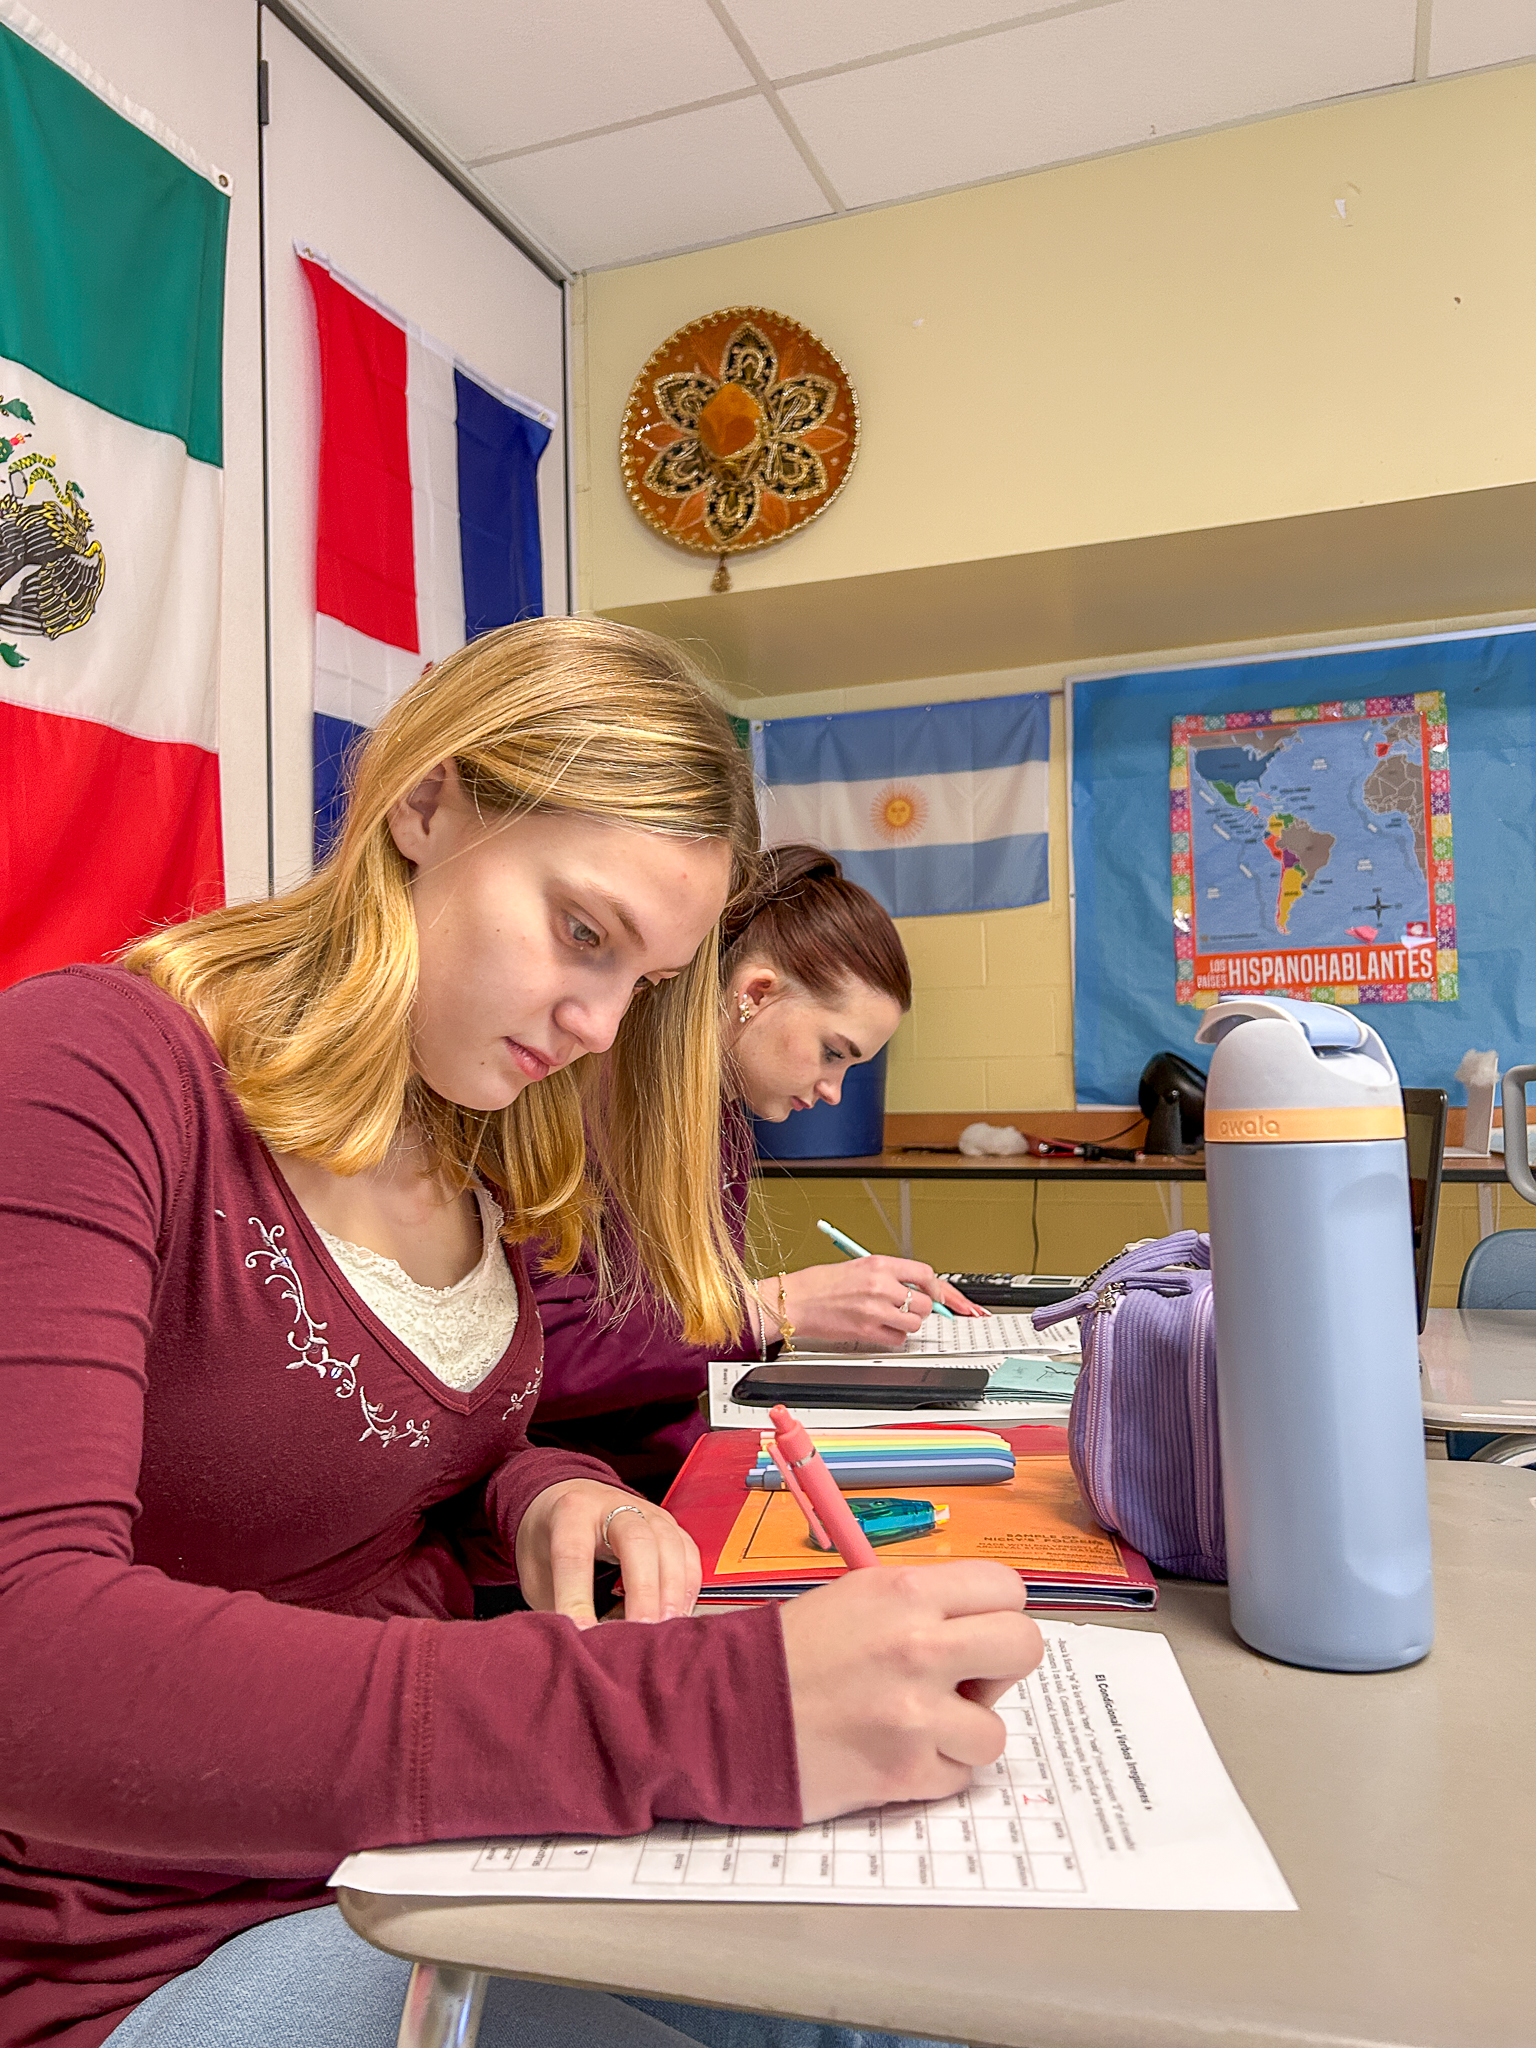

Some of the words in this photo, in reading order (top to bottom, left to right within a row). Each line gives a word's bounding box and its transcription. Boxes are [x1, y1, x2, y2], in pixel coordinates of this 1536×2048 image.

[1209, 958, 1228, 973] LOS
[1228, 947, 1433, 988] HISPANOHABLANTES
[1196, 972, 1228, 989] PAÍSES
[1219, 1114, 1280, 1138] owala
[1097, 1683, 1122, 1725] Condicional
[1115, 1734, 1135, 1759] Verbos
[1124, 1762, 1151, 1802] Irregulares
